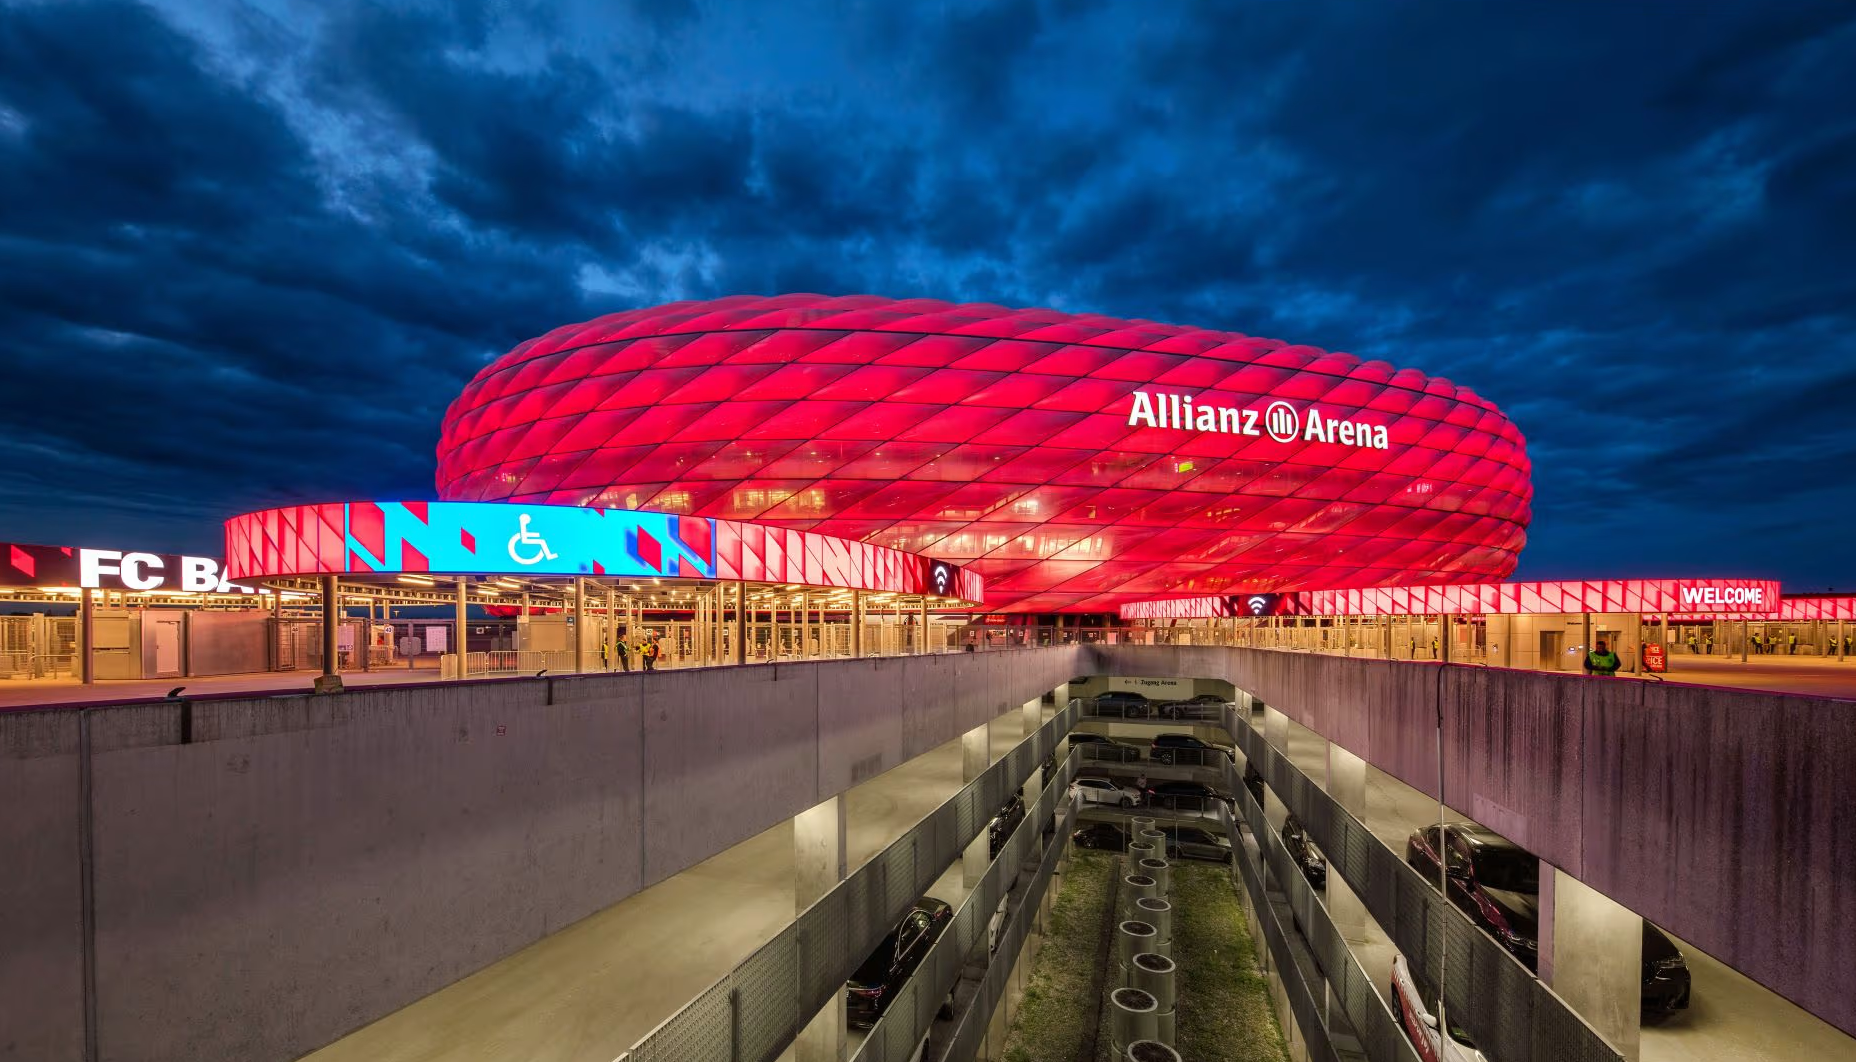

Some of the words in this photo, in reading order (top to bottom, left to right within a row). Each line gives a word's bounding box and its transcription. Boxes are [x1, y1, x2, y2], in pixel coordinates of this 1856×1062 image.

[1128, 391, 1260, 436] Allianz
[1303, 409, 1389, 450] Arena
[80, 548, 165, 590] FC
[181, 555, 271, 594] BA
[1682, 587, 1762, 604] WELCOME
